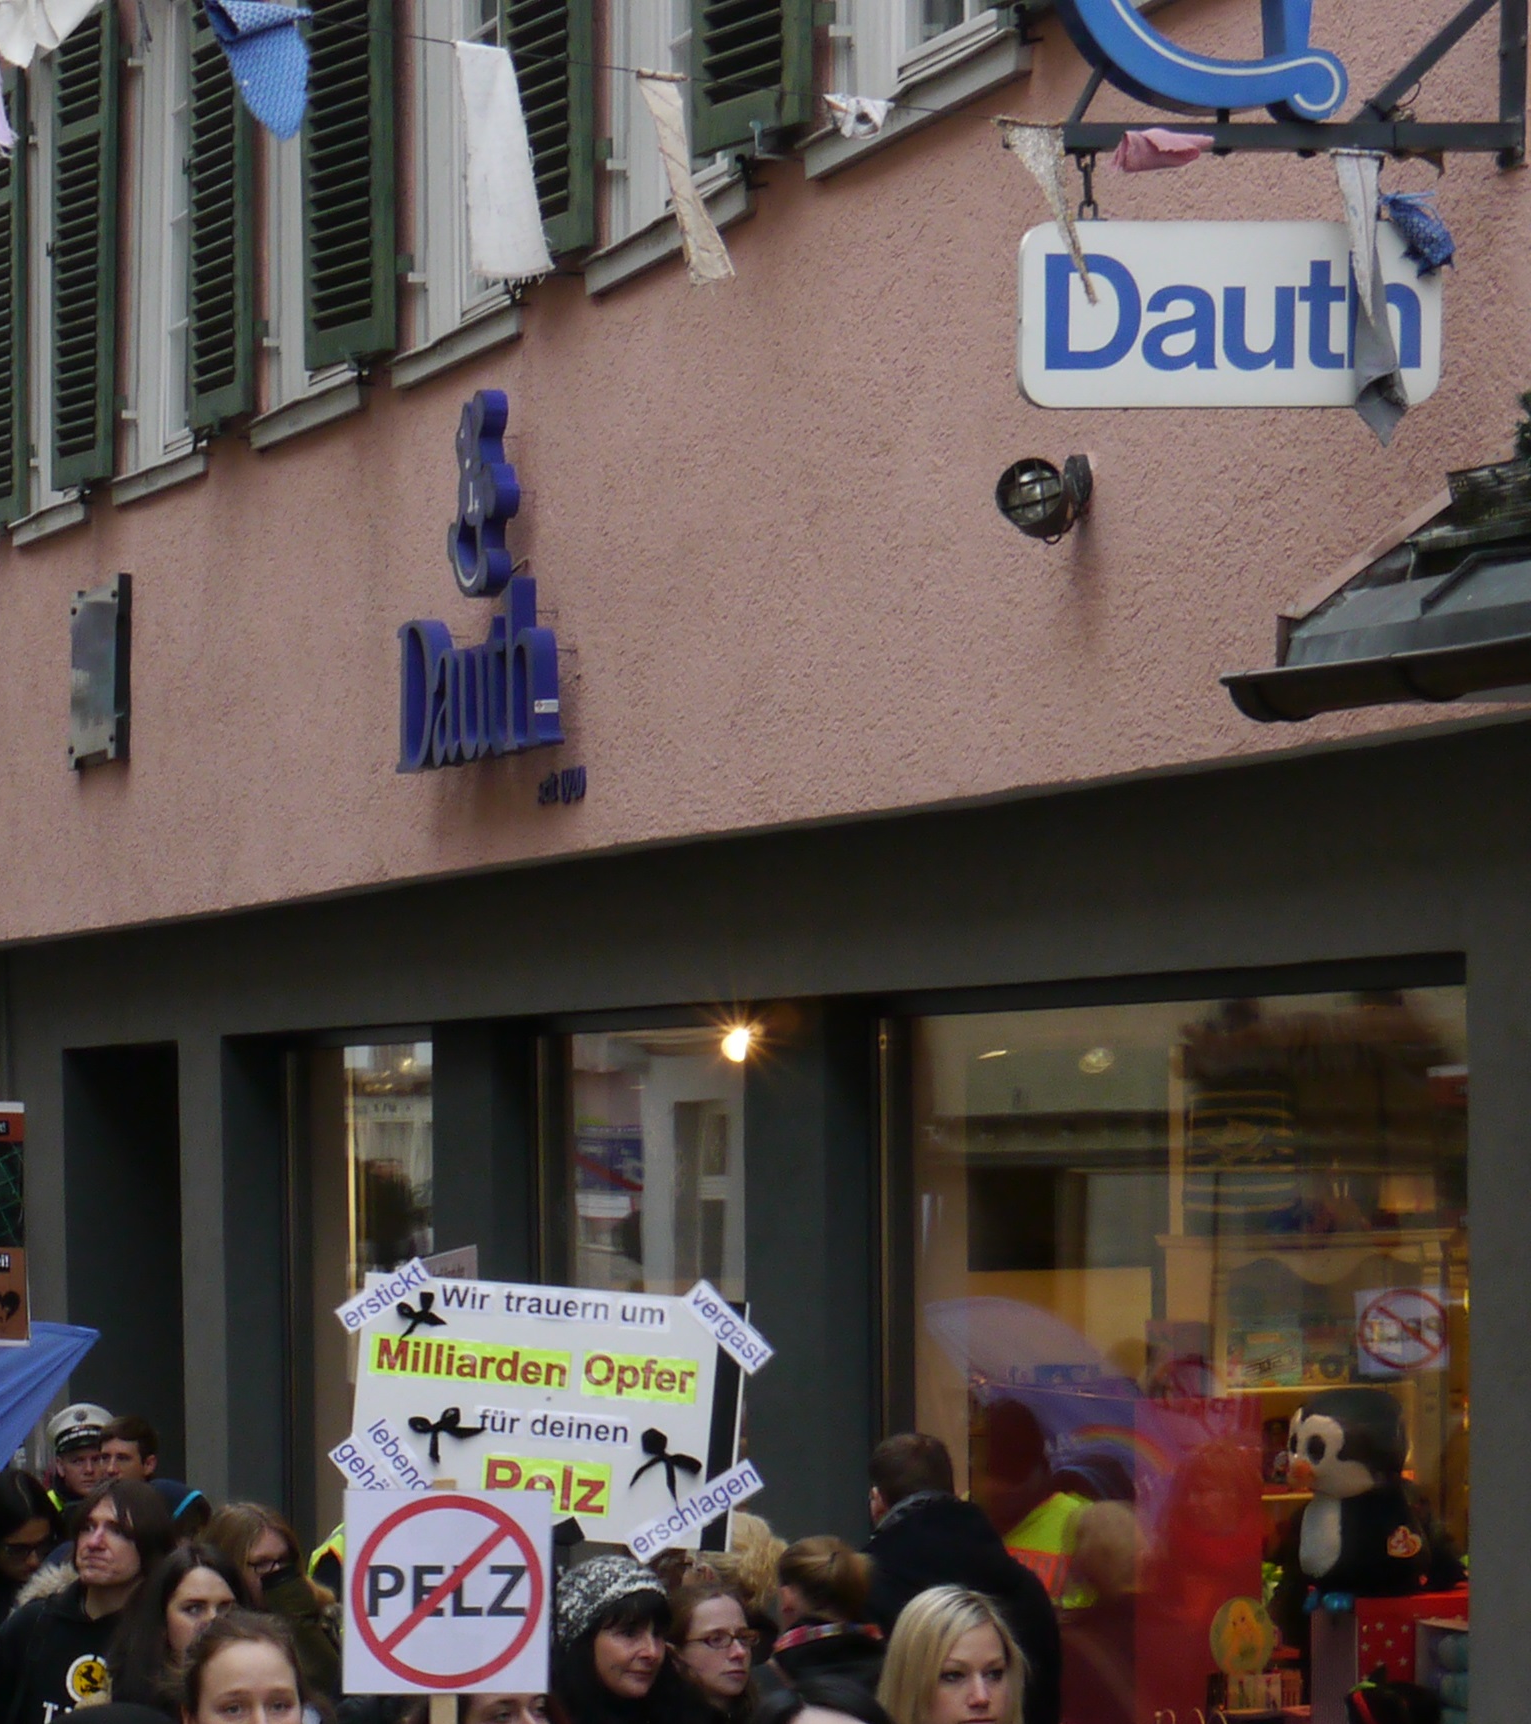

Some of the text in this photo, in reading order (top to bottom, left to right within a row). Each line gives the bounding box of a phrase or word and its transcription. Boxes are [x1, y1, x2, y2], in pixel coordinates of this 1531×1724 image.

[1044, 252, 1422, 372] Dauth
[344, 1264, 427, 1328] erstickt
[441, 1284, 665, 1326] Wir trauern um
[690, 1287, 771, 1368] vergast
[376, 1337, 696, 1395] Milliarden Opfer
[479, 1408, 630, 1444] für deinen
[632, 1465, 759, 1554] erschlagen
[366, 1564, 529, 1618] PELZ
